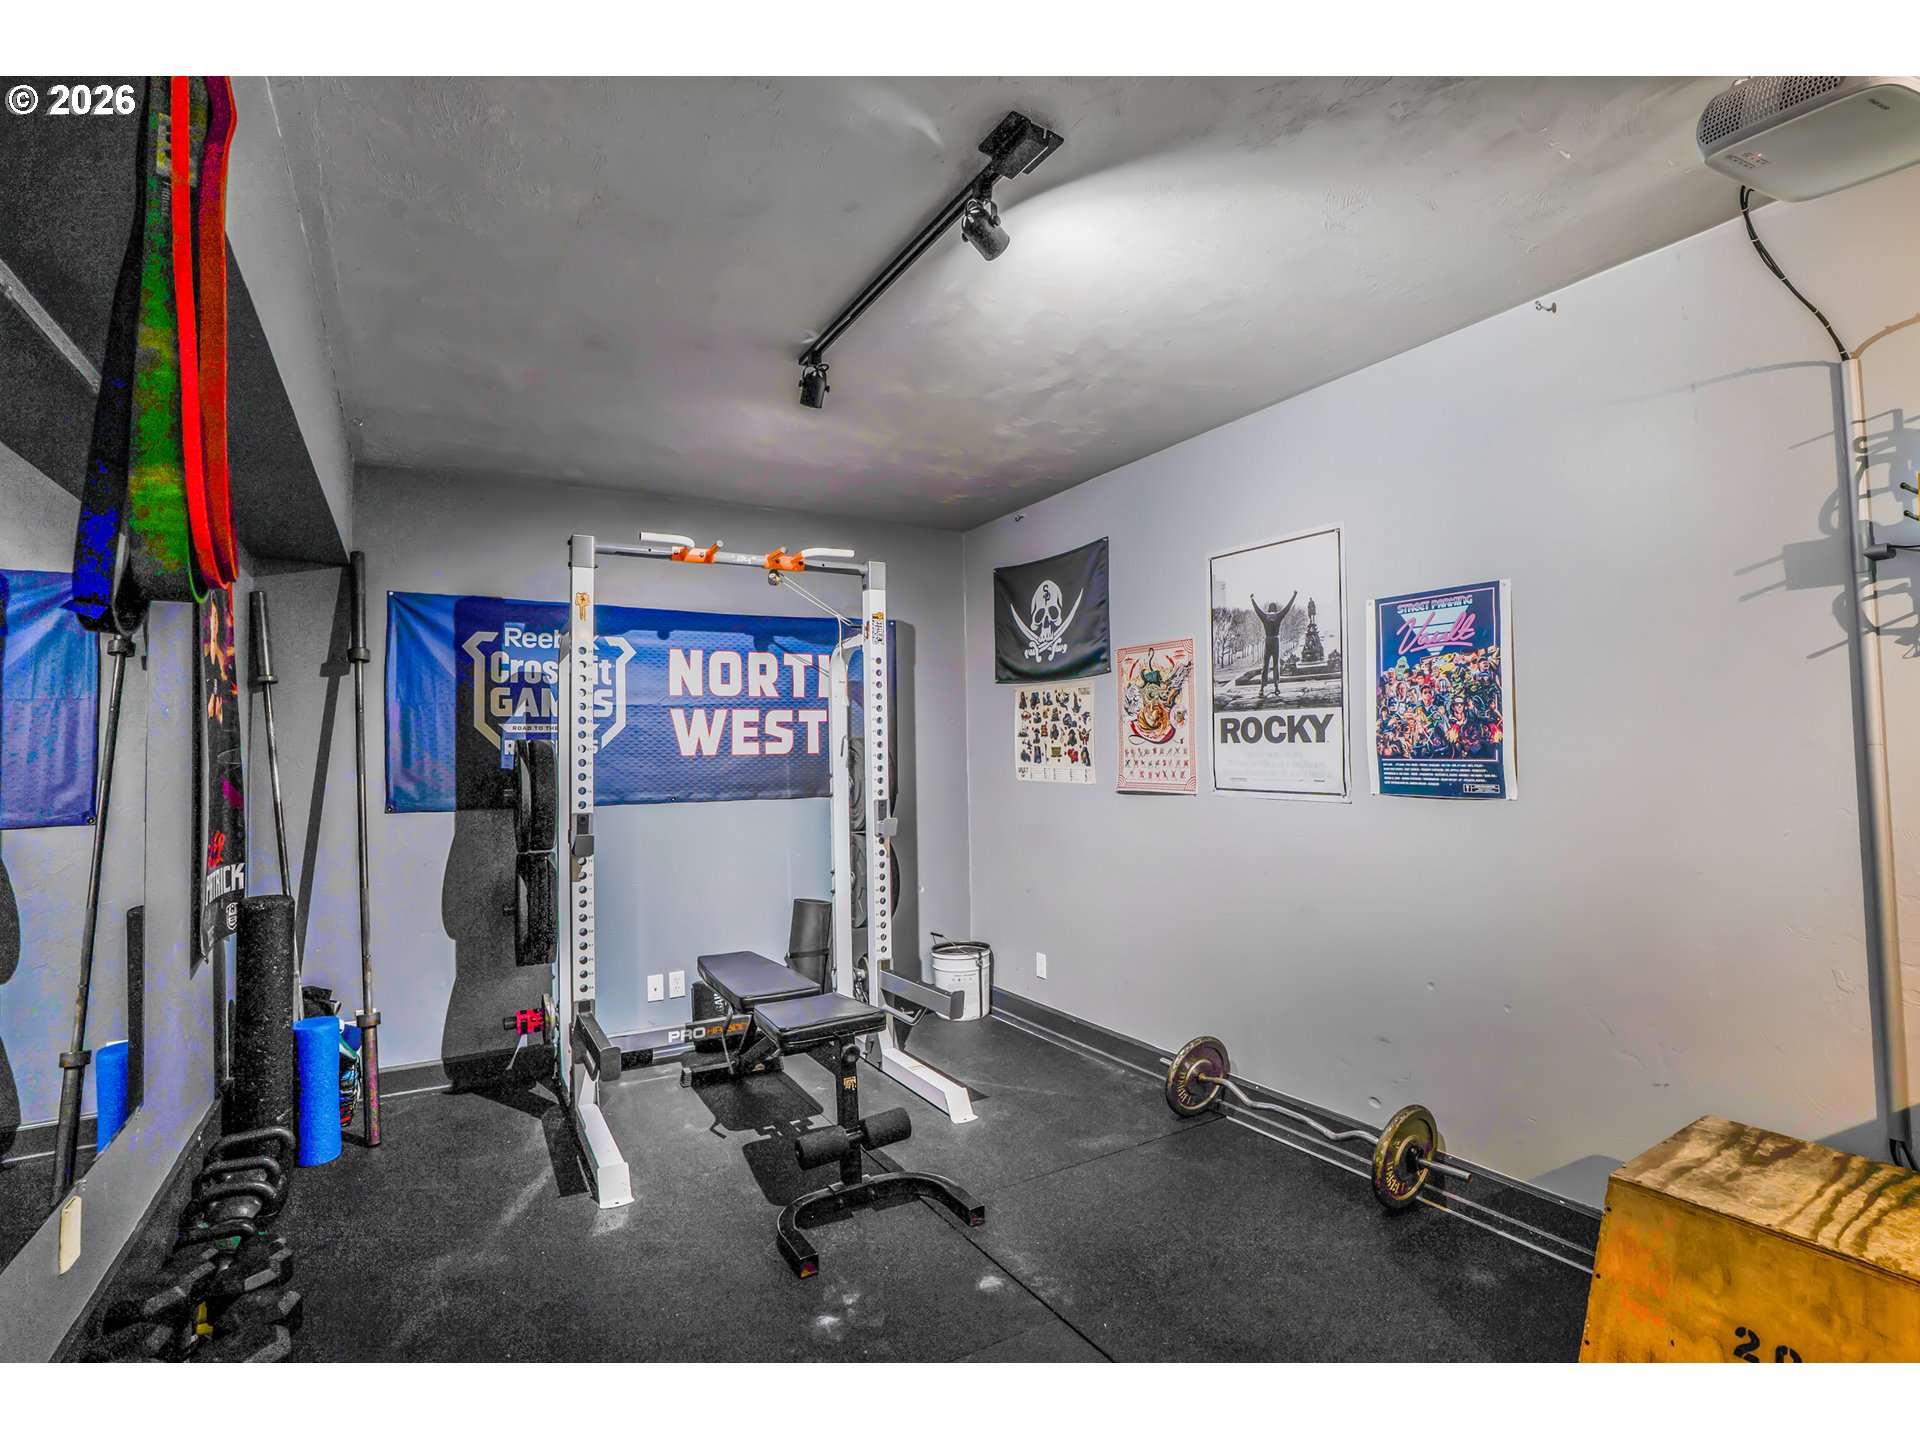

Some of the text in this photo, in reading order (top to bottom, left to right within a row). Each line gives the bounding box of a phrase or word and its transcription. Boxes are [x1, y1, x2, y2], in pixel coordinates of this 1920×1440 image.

[1397, 594, 1473, 614] STREET PARKING
[1396, 611, 1476, 655] Vault
[490, 687, 614, 718] GAMS
[670, 708, 828, 757] WEST
[1220, 714, 1334, 744] ROCKY
